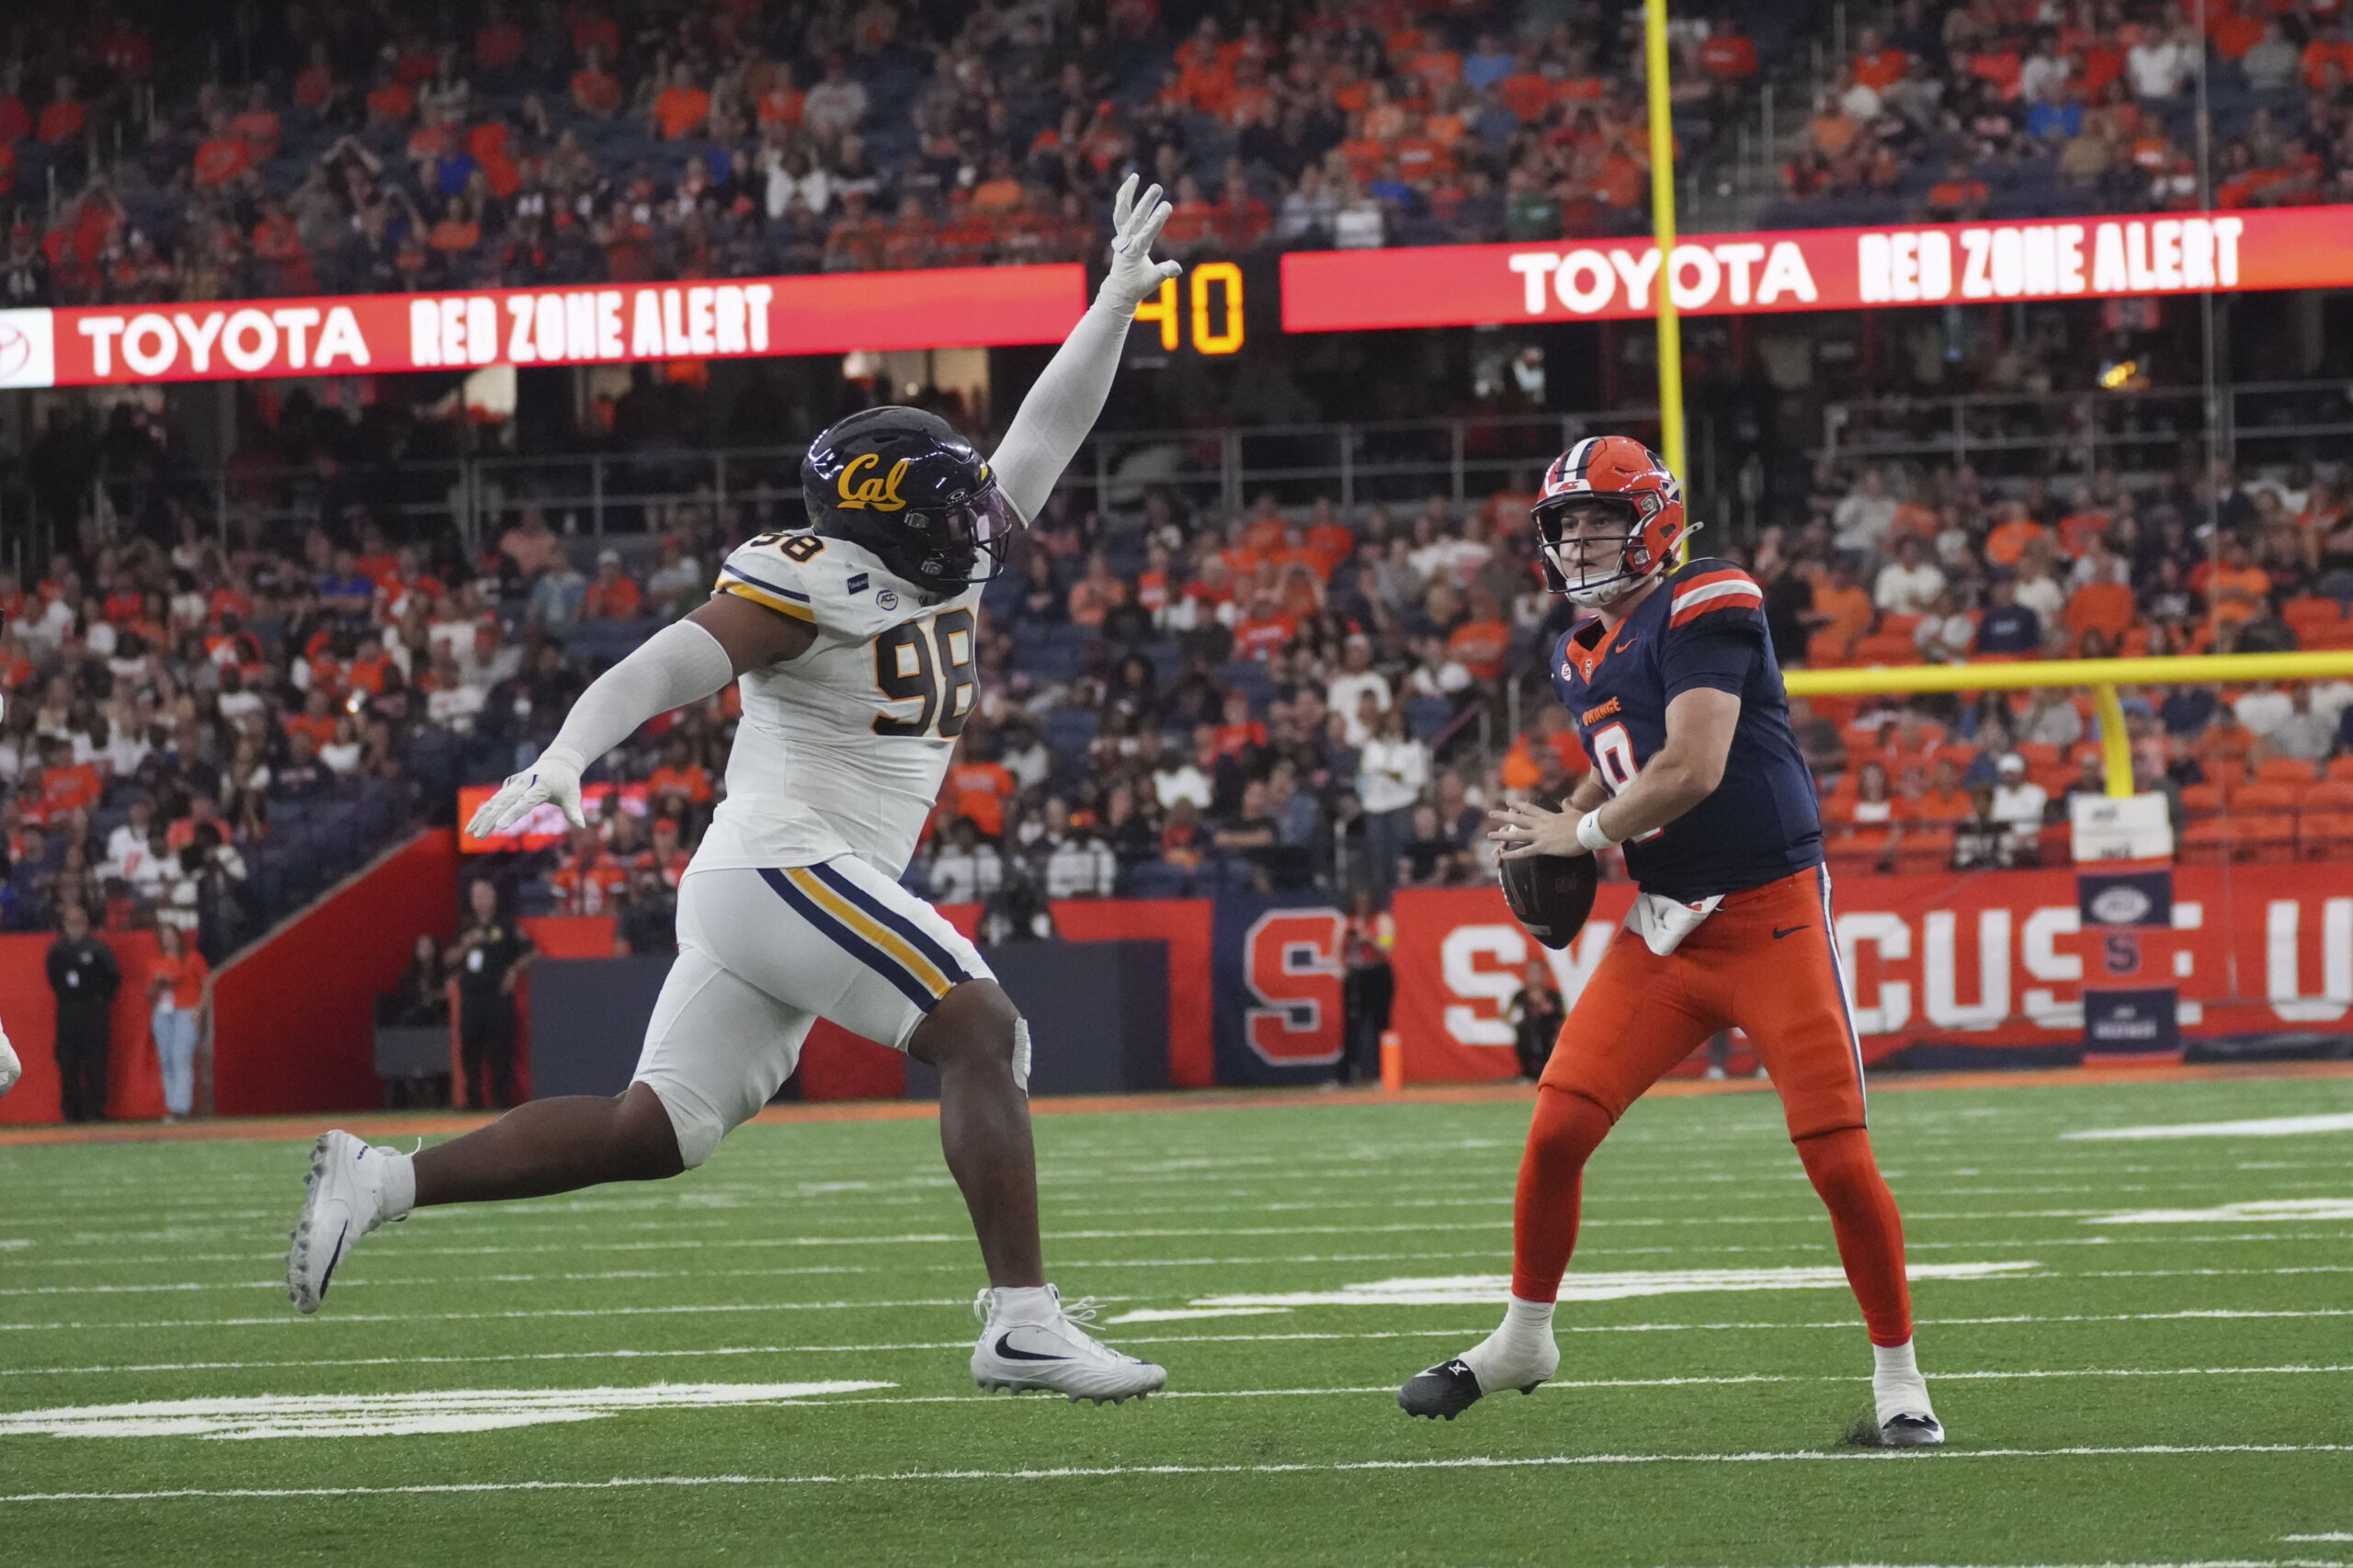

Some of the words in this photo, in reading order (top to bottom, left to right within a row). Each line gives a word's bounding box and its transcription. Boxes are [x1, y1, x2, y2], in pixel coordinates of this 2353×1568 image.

[1134, 262, 1245, 355] 40
[1508, 241, 1818, 314] TOYOTA
[1859, 231, 1952, 303] RED
[1960, 223, 2086, 299] ZONE
[2093, 217, 2244, 292] ALERT
[77, 306, 371, 377] TOYOTA
[410, 296, 497, 367] RED
[506, 290, 624, 362] ZONE
[631, 284, 773, 358] ALERT
[837, 453, 910, 512] Cal
[870, 607, 981, 741] 98
[1582, 696, 1621, 727] ORANGE
[1245, 906, 1347, 1066] S
